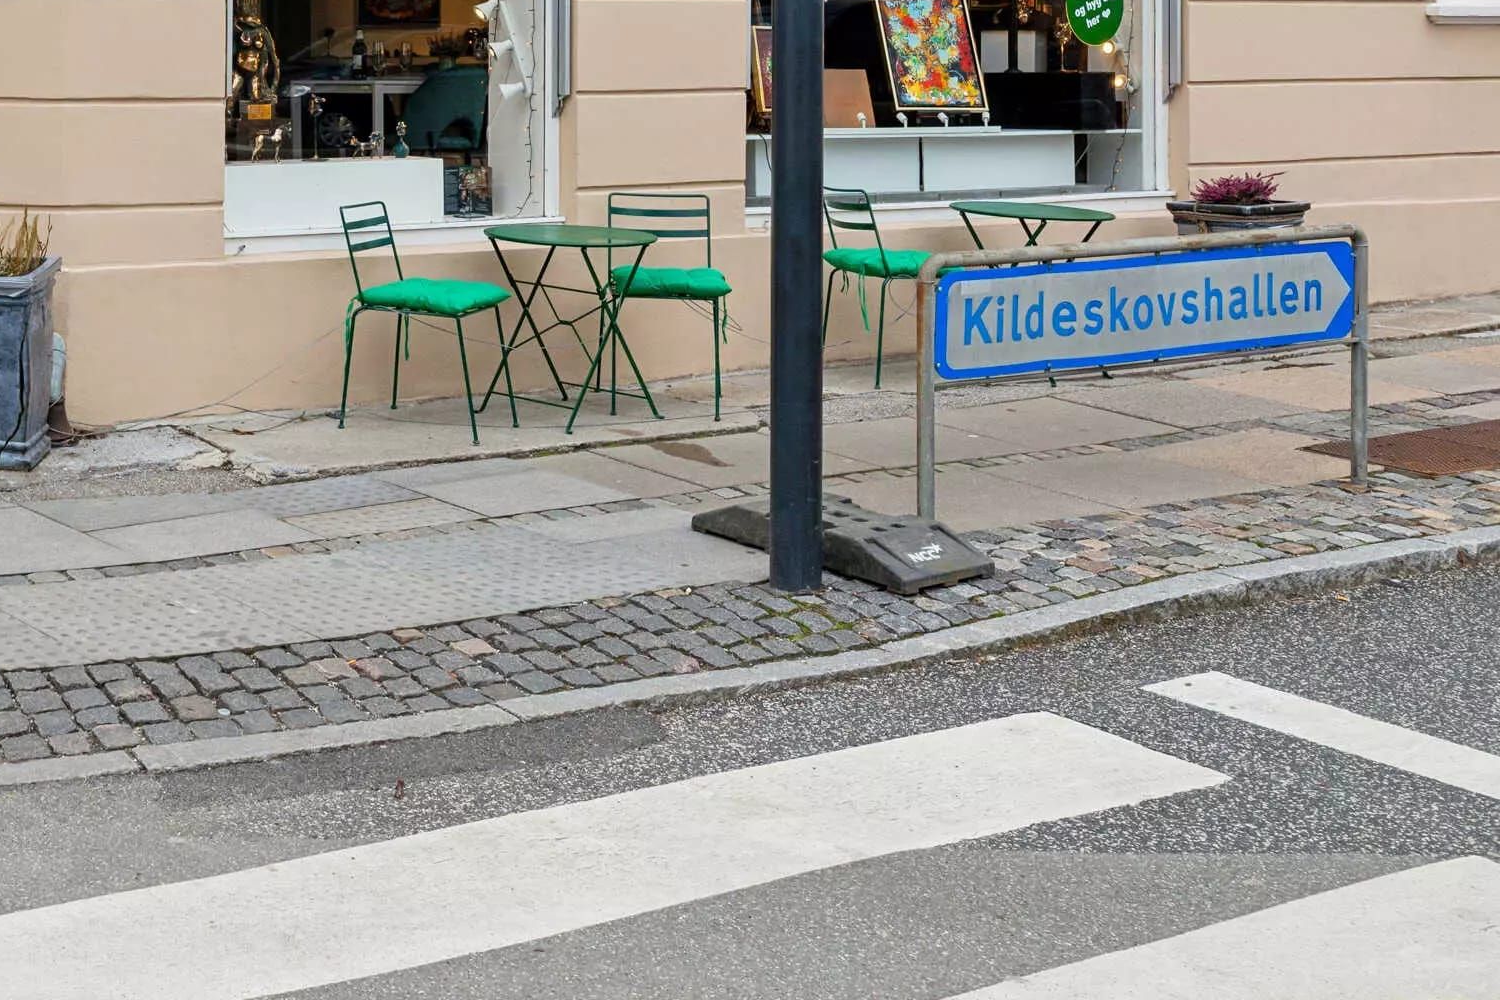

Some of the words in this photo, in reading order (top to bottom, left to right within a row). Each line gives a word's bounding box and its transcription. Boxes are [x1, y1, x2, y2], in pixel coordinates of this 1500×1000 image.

[1074, 6, 1086, 18] og
[1086, 15, 1100, 29] her
[962, 272, 1323, 346] Kildeskovshallen
